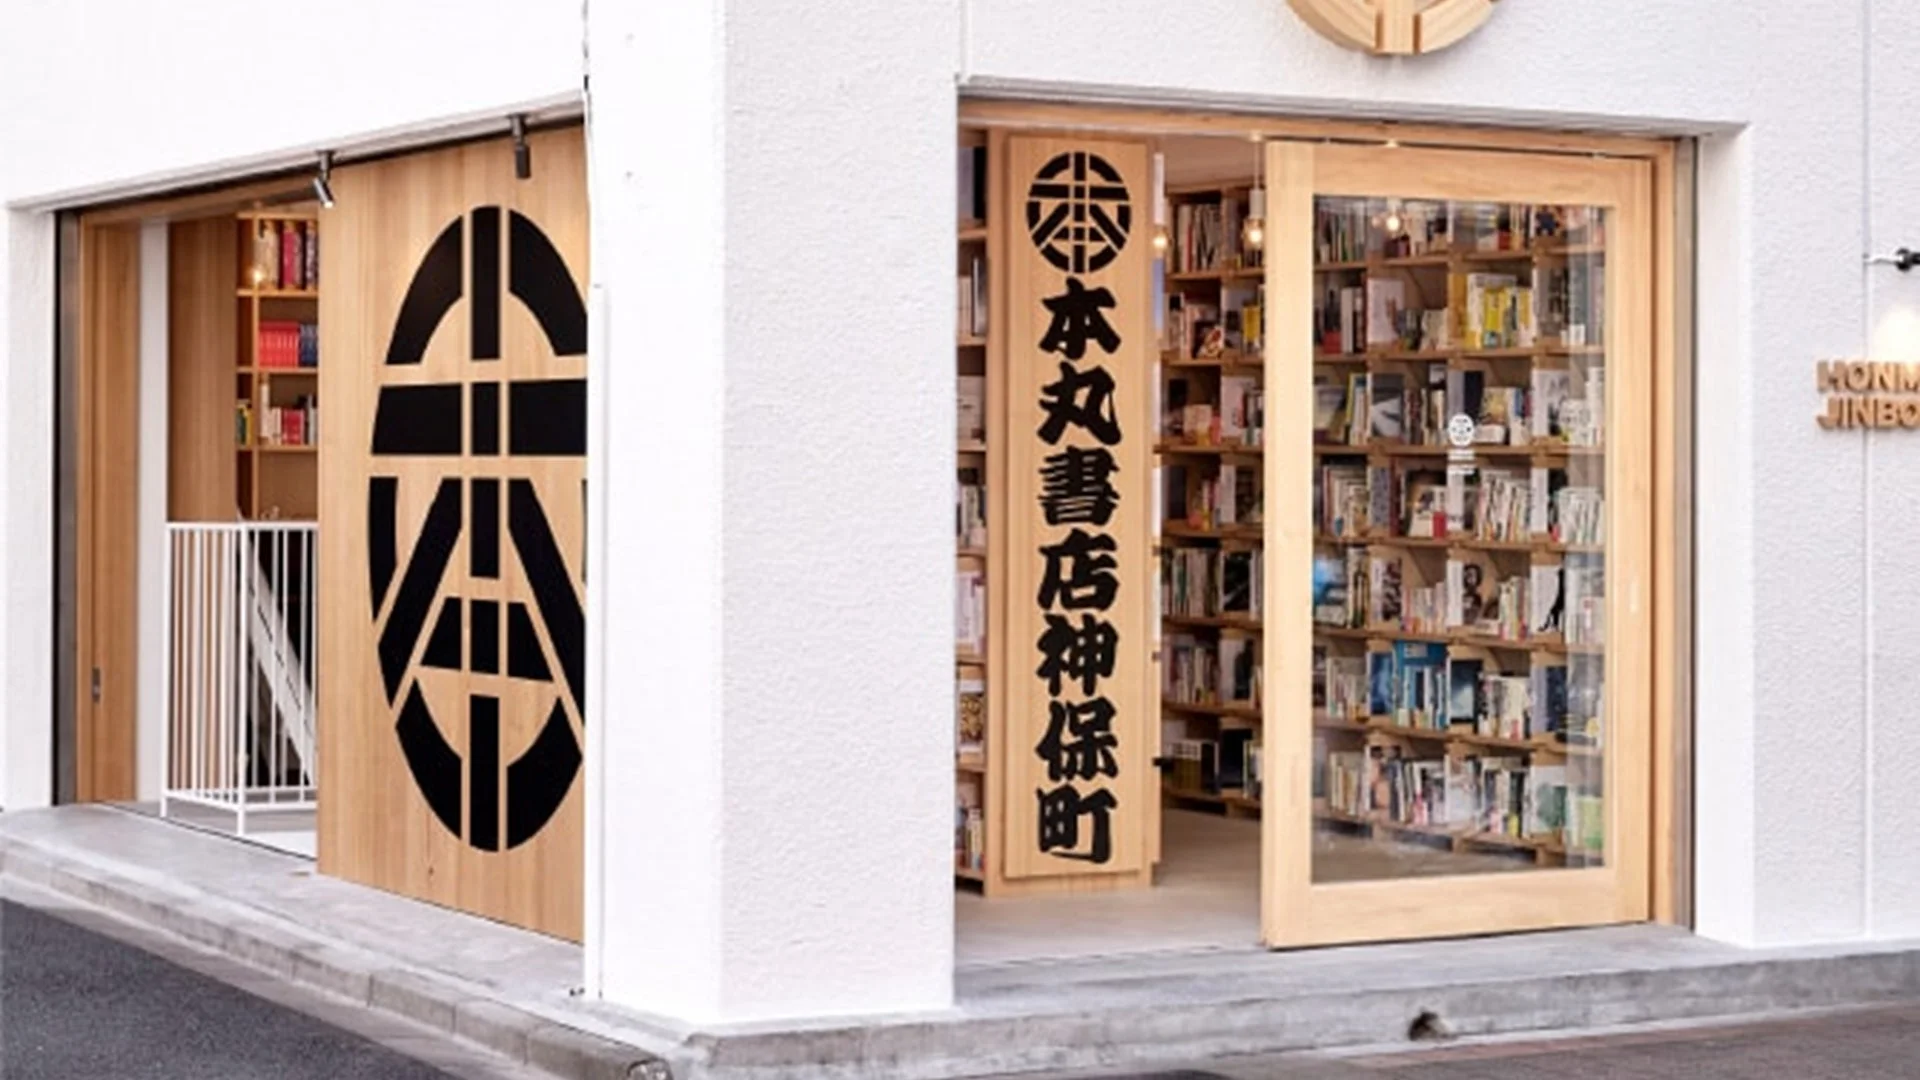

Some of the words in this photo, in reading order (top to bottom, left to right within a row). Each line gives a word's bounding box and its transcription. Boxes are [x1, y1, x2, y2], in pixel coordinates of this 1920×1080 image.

[1816, 397, 1920, 431] JINBO
[1036, 276, 1122, 864] 本丸書店神保町
